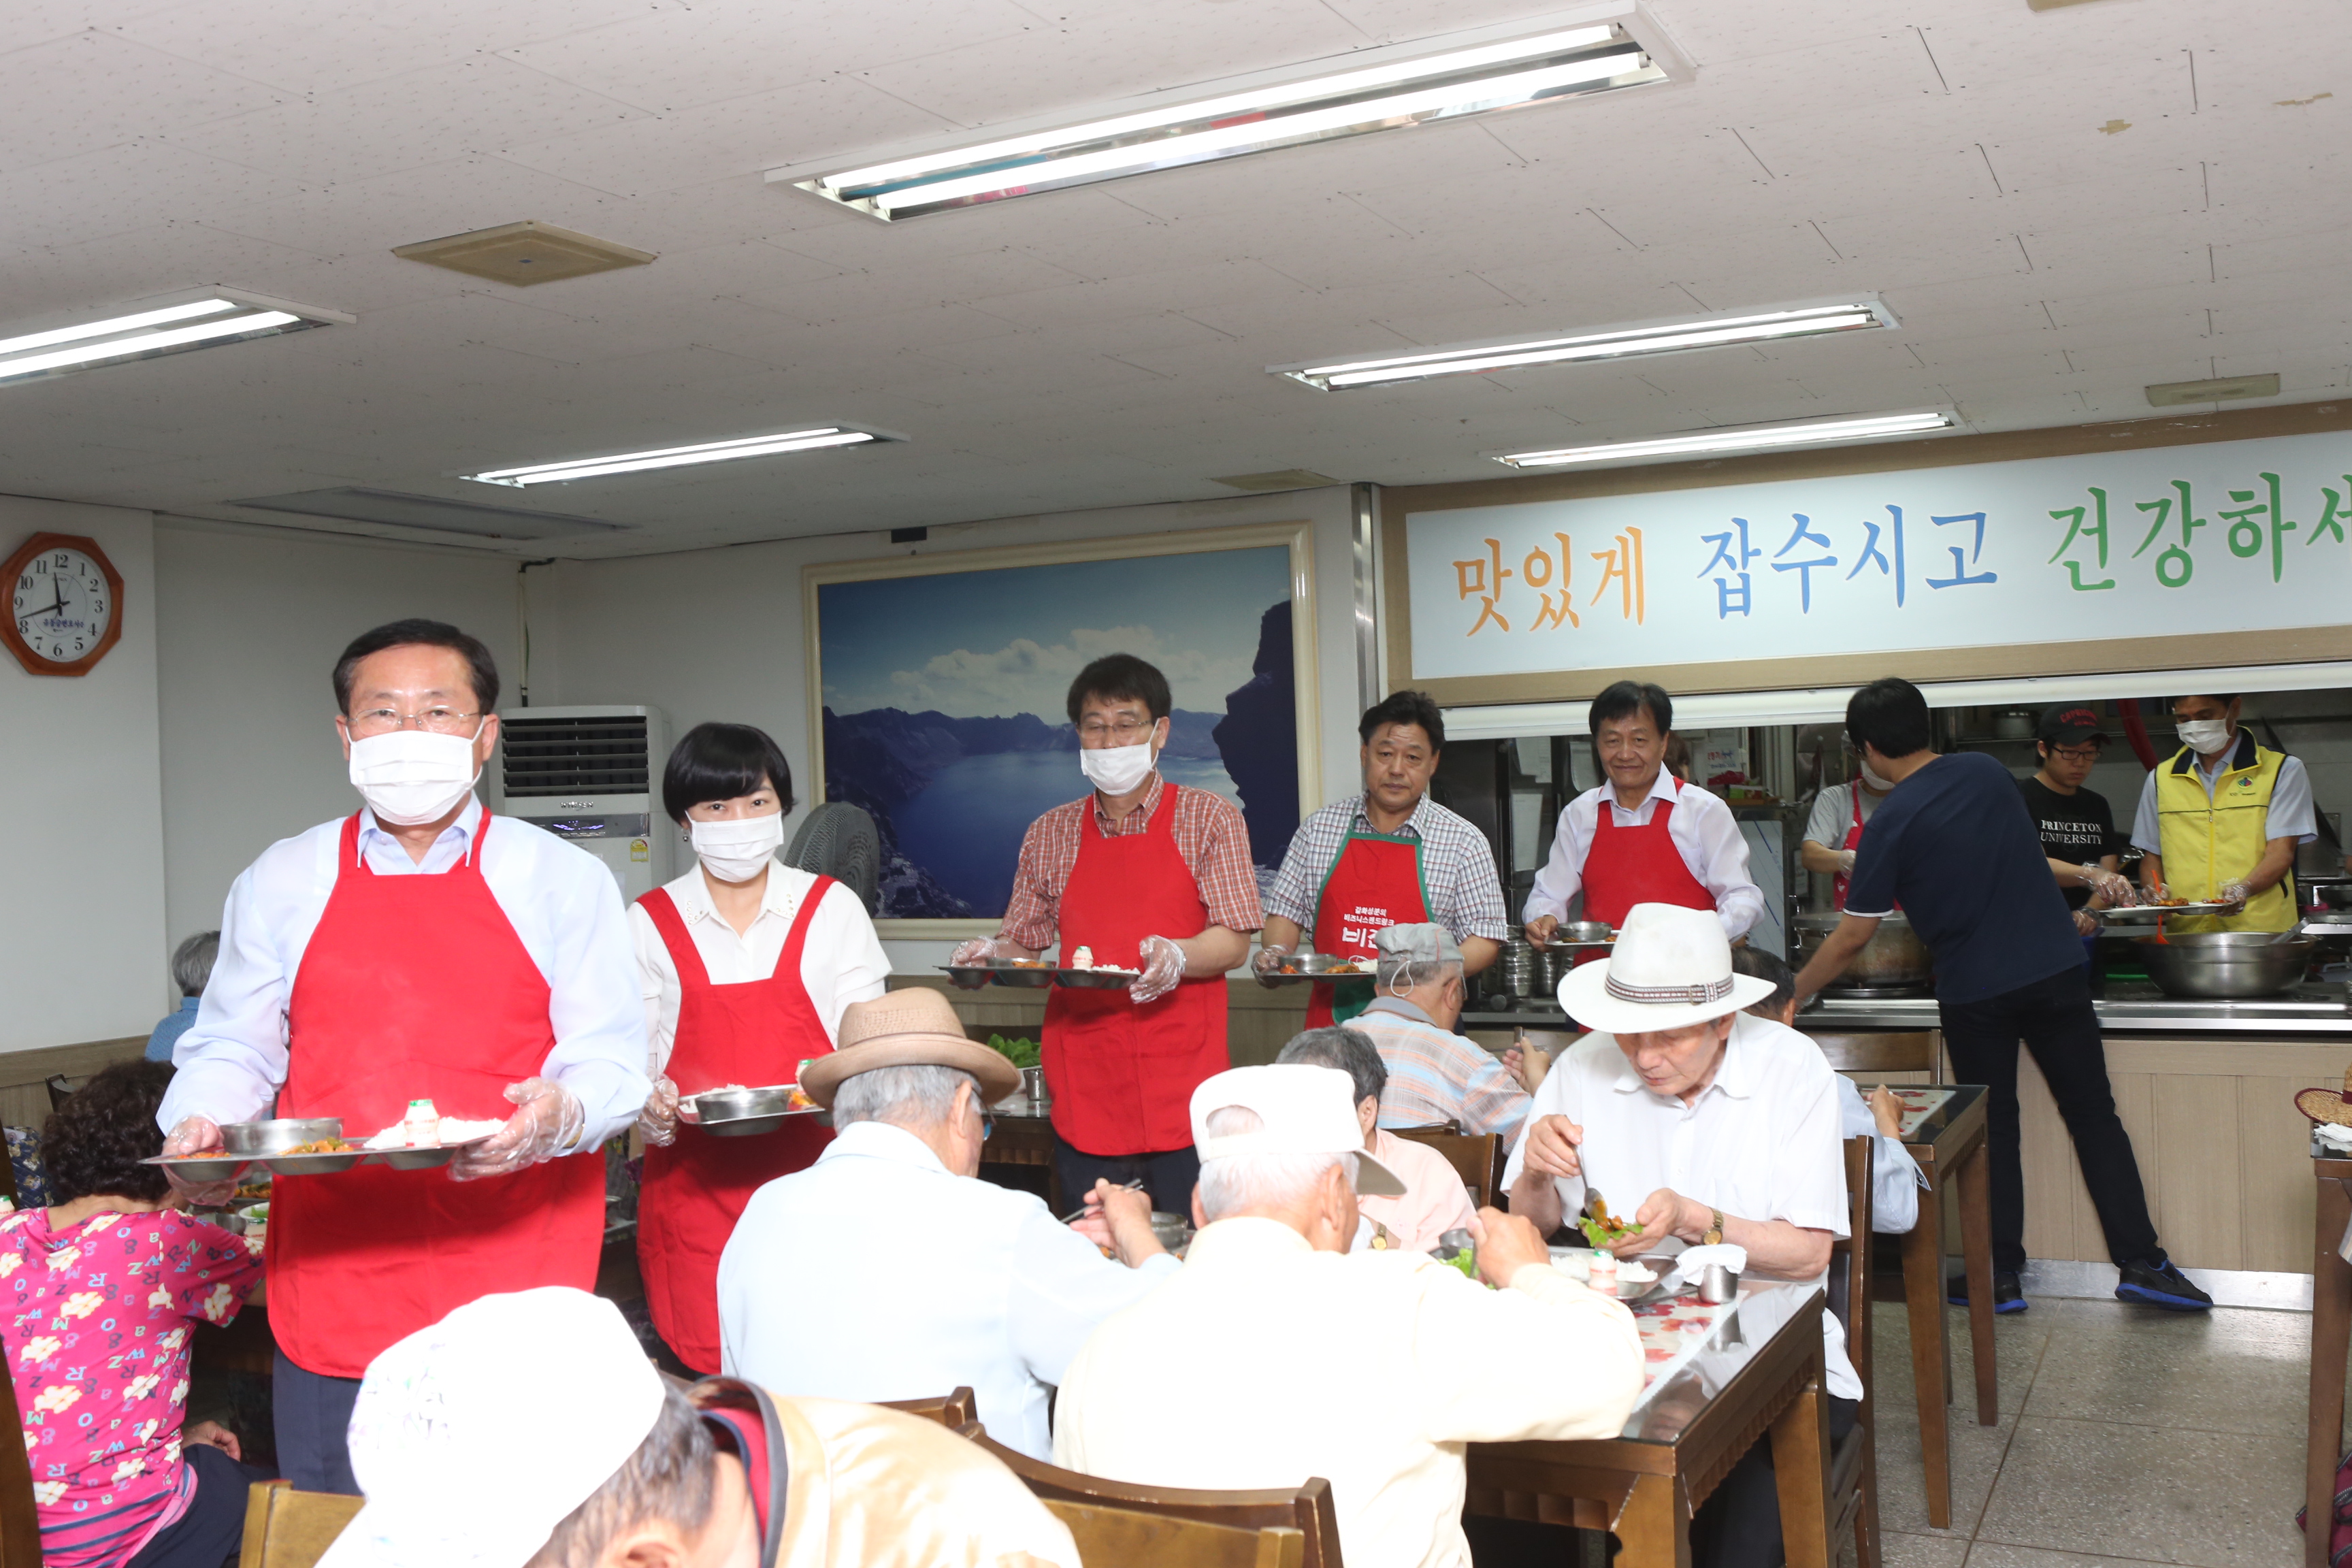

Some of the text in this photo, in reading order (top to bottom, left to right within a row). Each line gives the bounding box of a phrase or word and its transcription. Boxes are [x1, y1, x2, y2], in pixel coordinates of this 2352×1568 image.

[36, 560, 47, 574] 11
[54, 554, 68, 568] 12
[80, 563, 85, 576] 1
[1452, 525, 1646, 637] 맛있게
[1697, 504, 1998, 620] 잡수시고
[20, 576, 33, 589] 10
[90, 579, 99, 592] 2
[14, 596, 23, 610] 9
[95, 600, 103, 613] 3
[20, 620, 29, 634] 8
[88, 623, 97, 636] 4
[35, 637, 43, 650] 7
[54, 643, 63, 656] 6
[75, 637, 84, 650] 5
[2041, 819, 2102, 833] PRINCETON
[2040, 832, 2102, 845] UNIVERSITY
